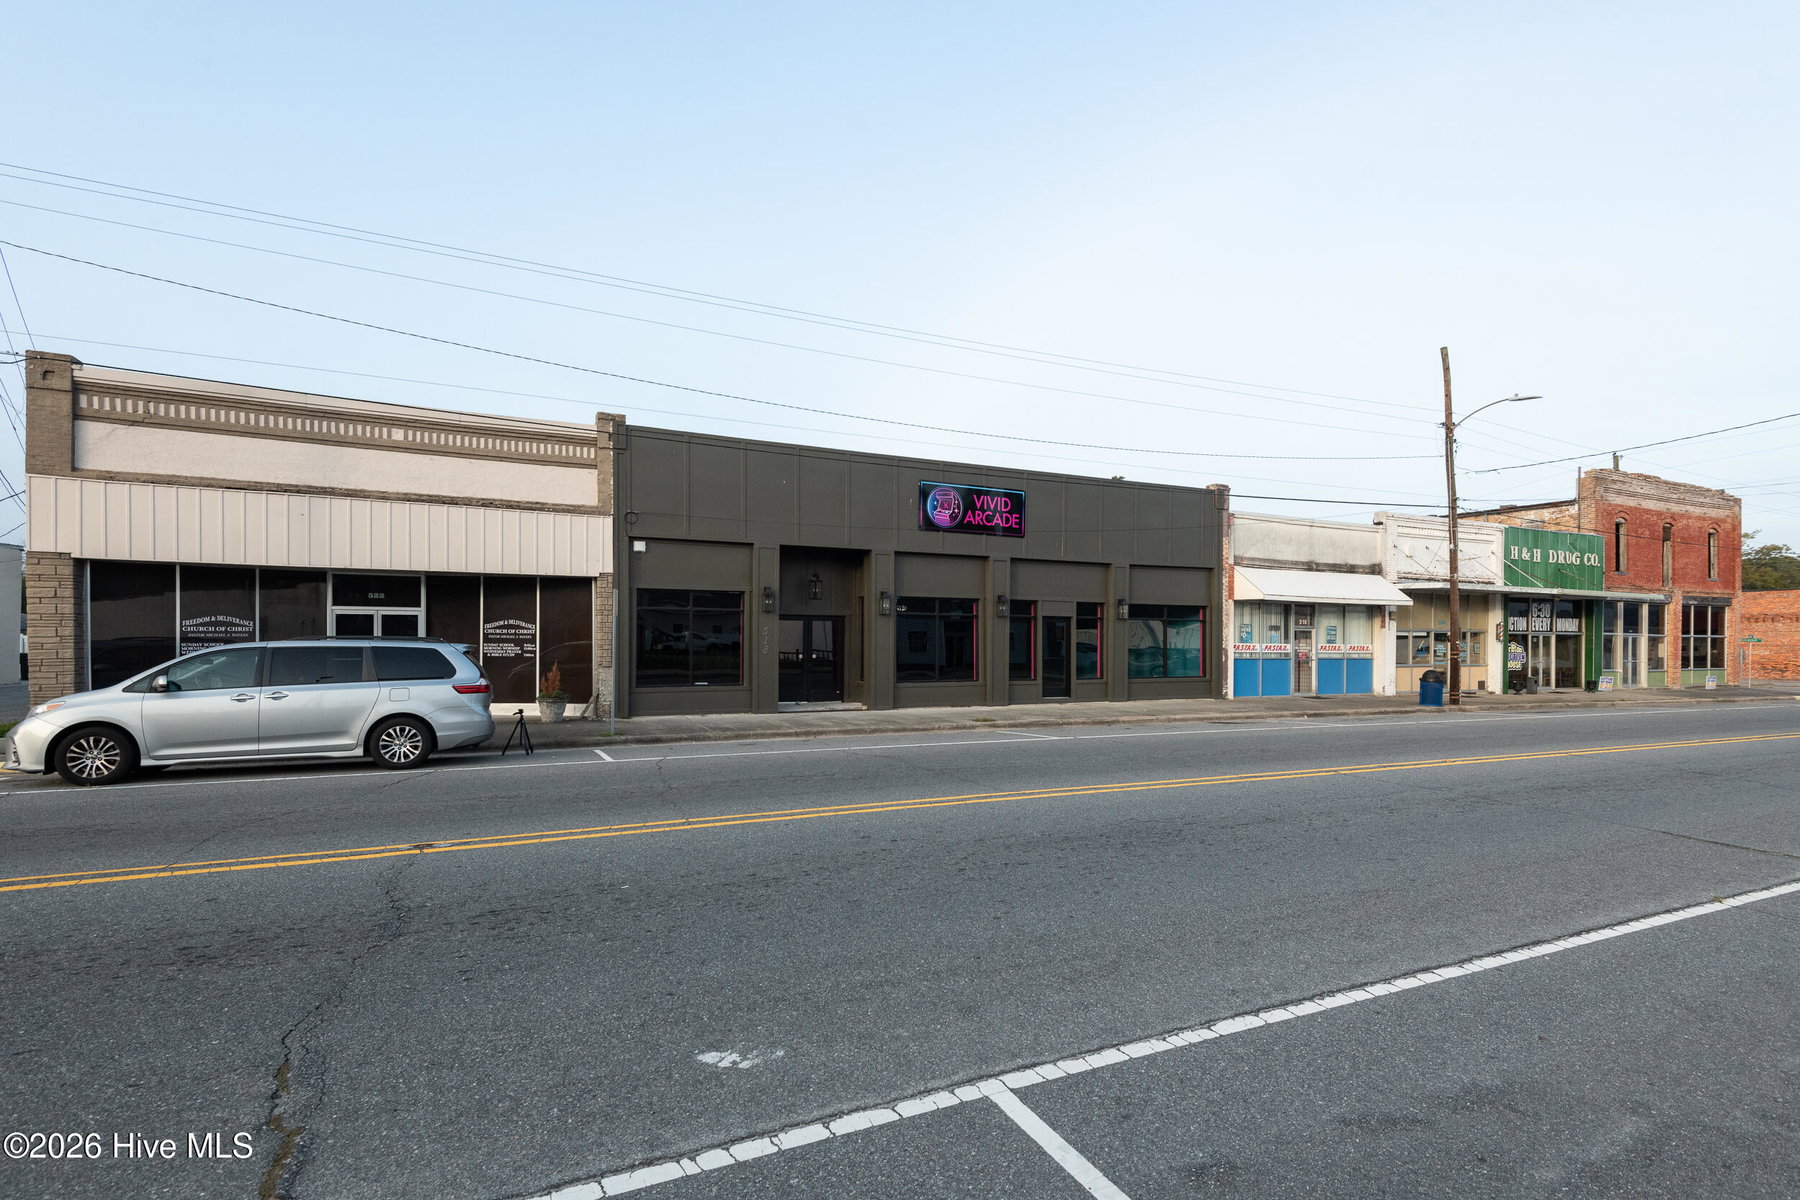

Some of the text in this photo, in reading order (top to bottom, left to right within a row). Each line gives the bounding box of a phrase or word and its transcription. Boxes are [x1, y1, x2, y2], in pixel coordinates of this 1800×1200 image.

[973, 494, 1011, 512] VIVID
[963, 510, 1020, 529] ARCADE
[1548, 549, 1581, 566] DRUG
[1584, 553, 1601, 567] CO.
[1532, 603, 1551, 618] 6:30
[182, 615, 210, 626] FREEDOM
[217, 615, 254, 627] DELIVERANCE
[1531, 617, 1551, 631] EVERY
[1556, 618, 1580, 632] MONDAY
